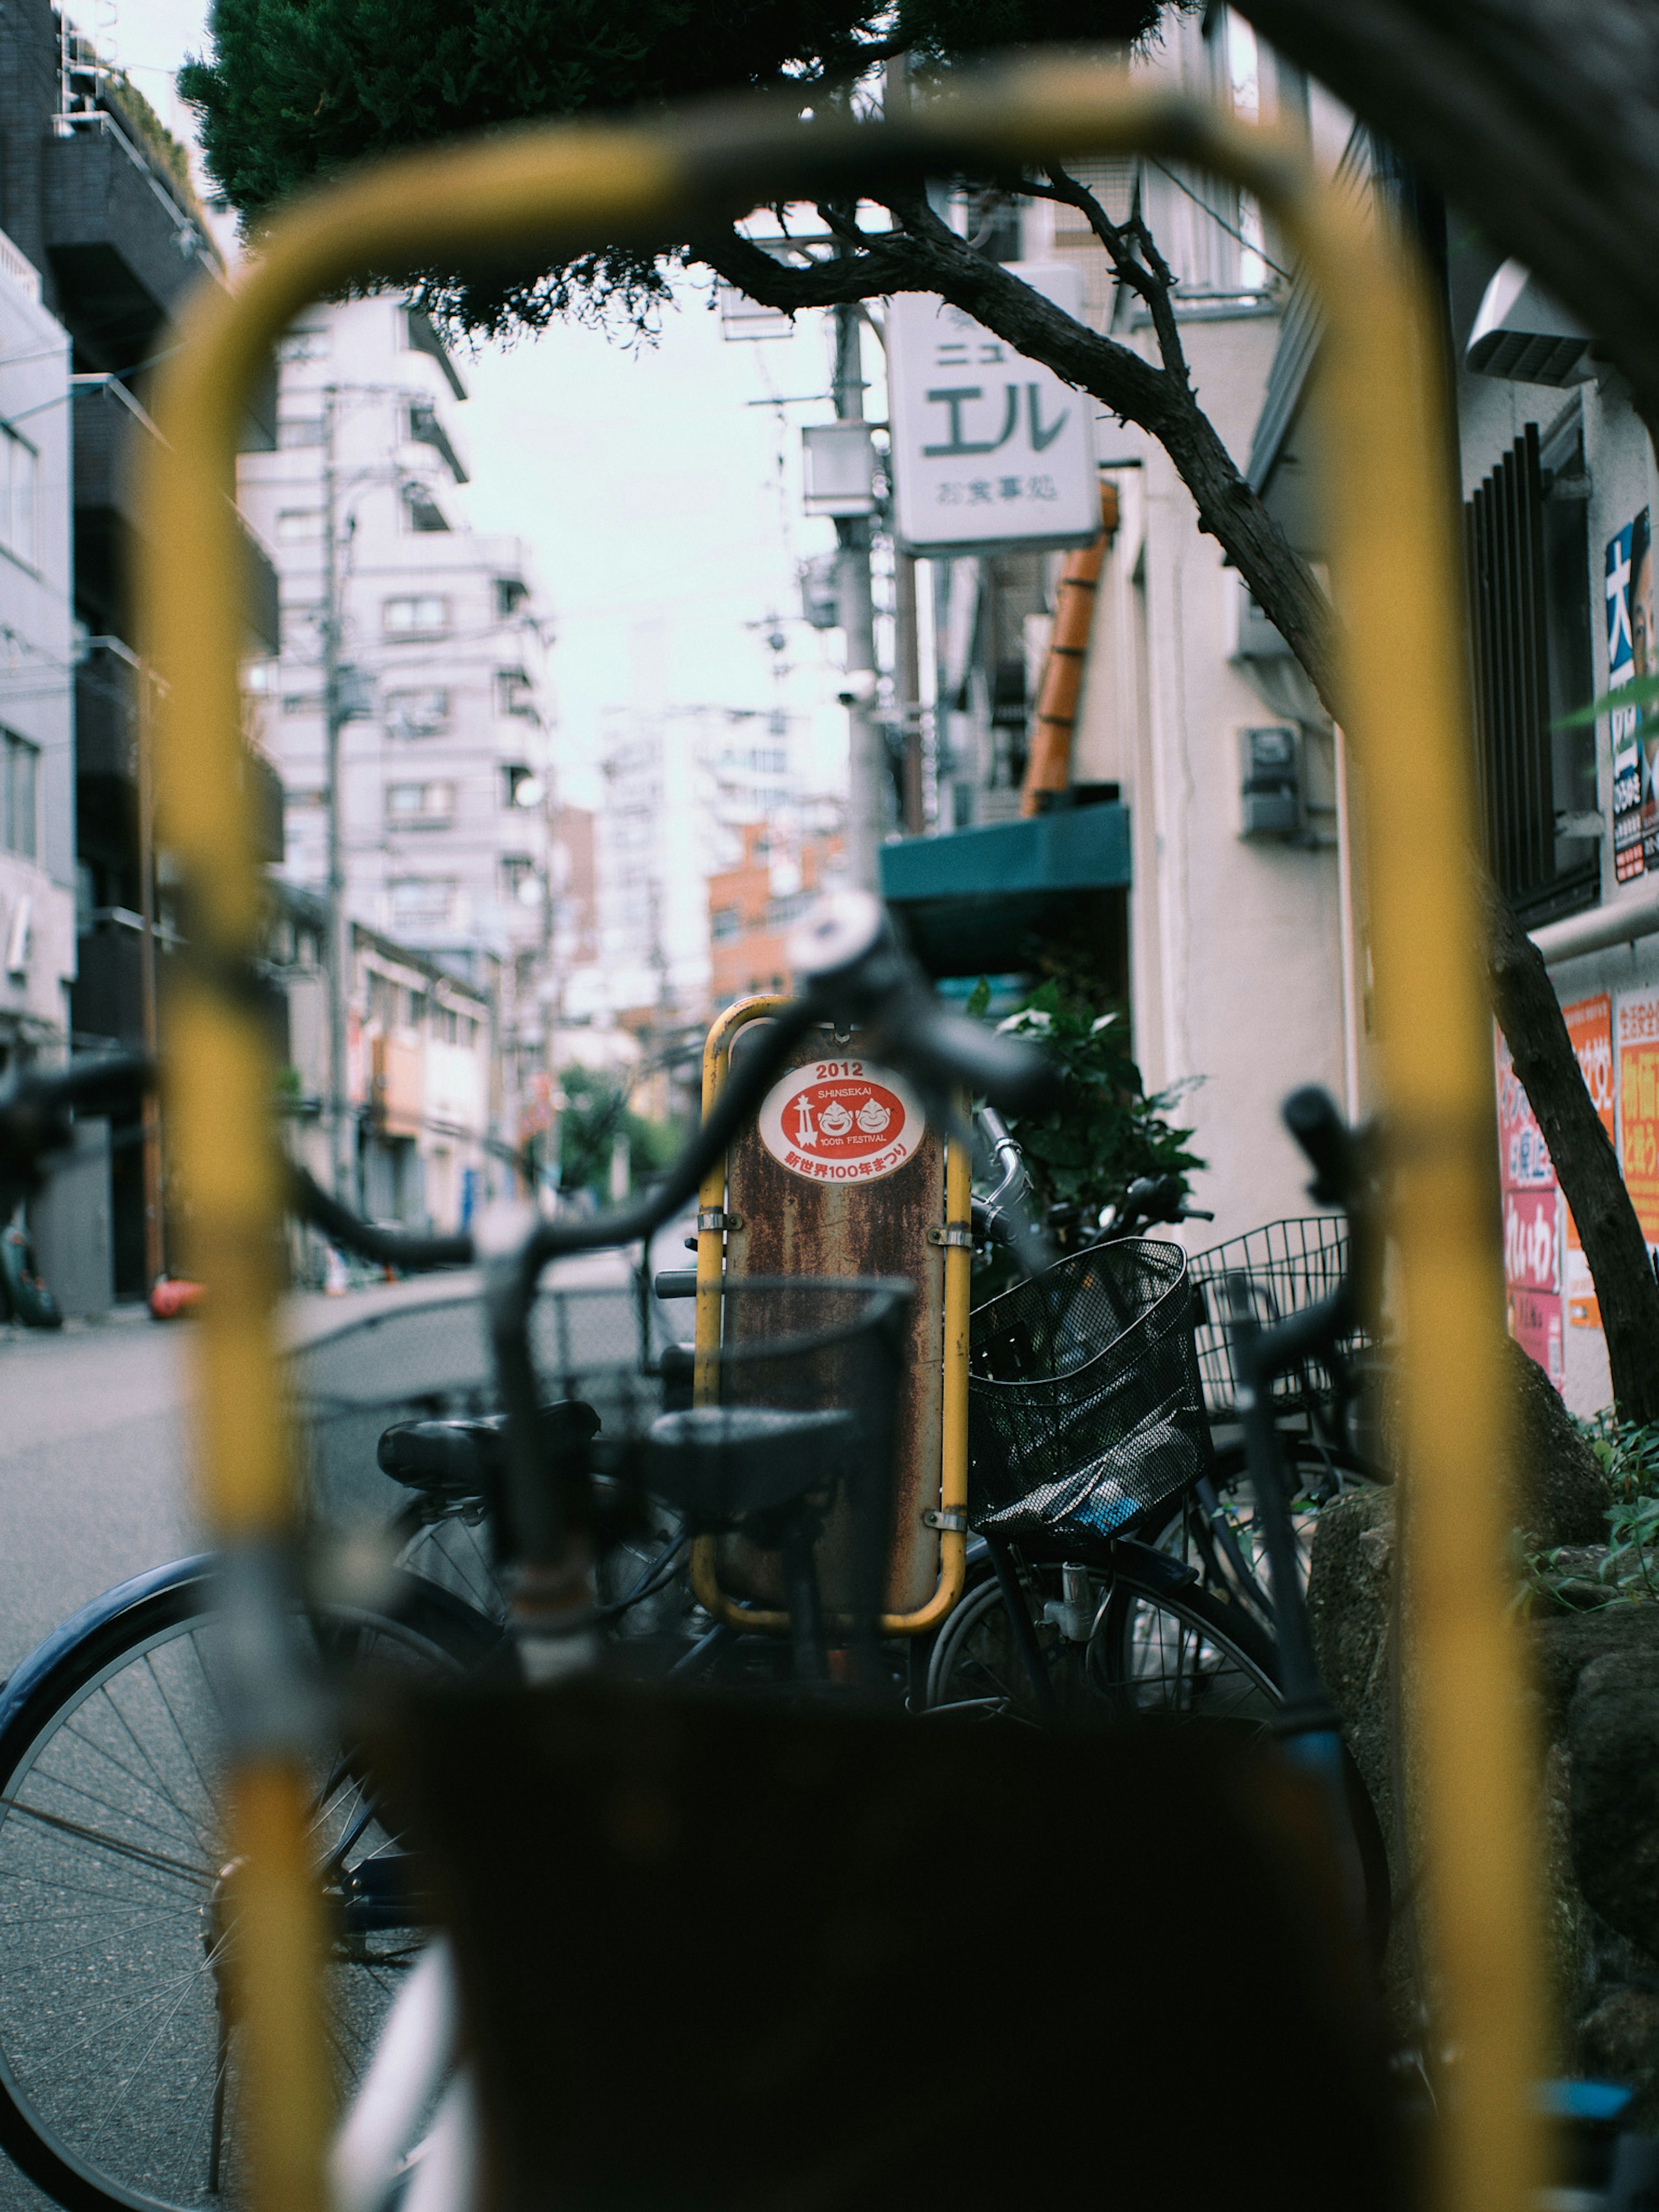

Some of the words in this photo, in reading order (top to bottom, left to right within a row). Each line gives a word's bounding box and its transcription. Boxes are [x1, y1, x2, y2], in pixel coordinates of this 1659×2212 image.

[922, 381, 1071, 458] エル
[938, 475, 1058, 505] お食事処
[816, 1062, 863, 1079] 2012
[818, 1087, 871, 1099] SHINSEKAI
[1622, 1051, 1659, 1121] 物価
[820, 1135, 844, 1146] 100th
[847, 1134, 887, 1144] FESTIVAL
[784, 1143, 907, 1179] 新世界100年まつり
